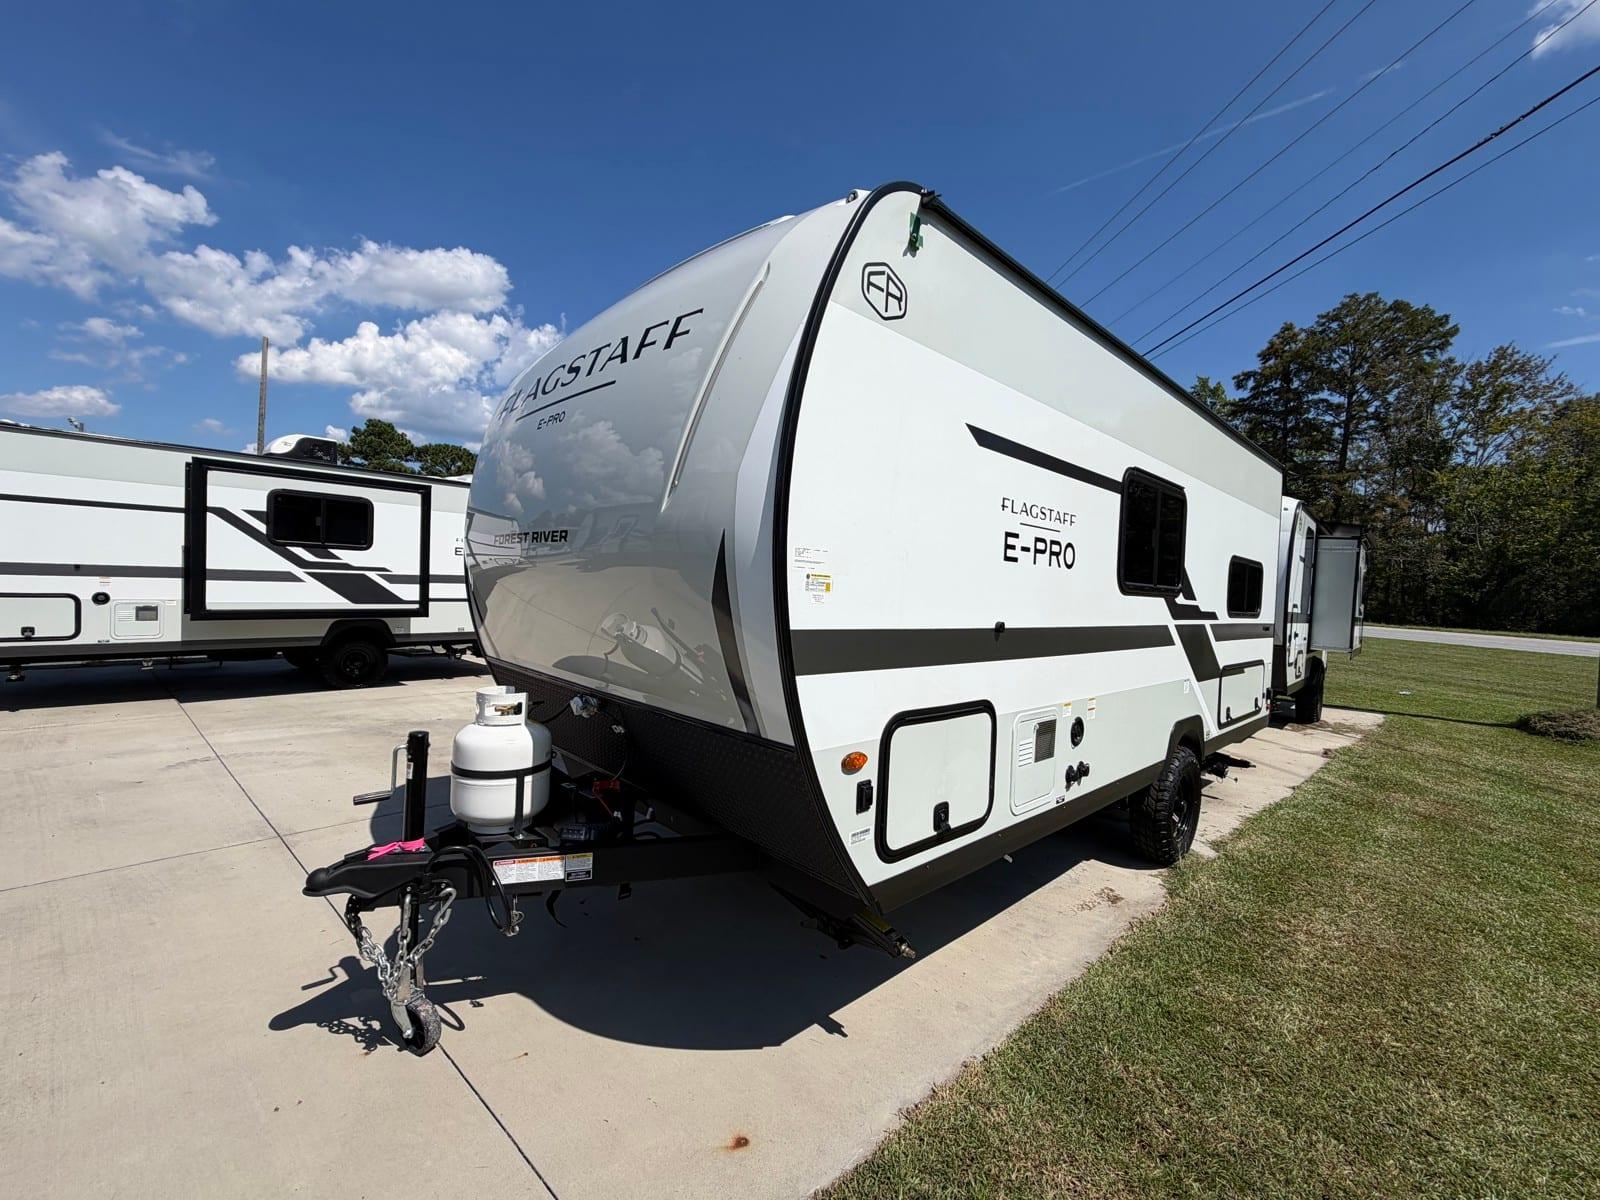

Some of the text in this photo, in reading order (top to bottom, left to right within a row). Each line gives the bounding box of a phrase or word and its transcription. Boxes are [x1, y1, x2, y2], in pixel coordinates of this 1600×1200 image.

[498, 307, 705, 421] FLAGSTAFF
[536, 410, 566, 430] E-PRO
[1000, 496, 1077, 527] FLAGSTAFF
[494, 529, 569, 545] FOREST RIVER
[1003, 531, 1076, 570] E-PRO
